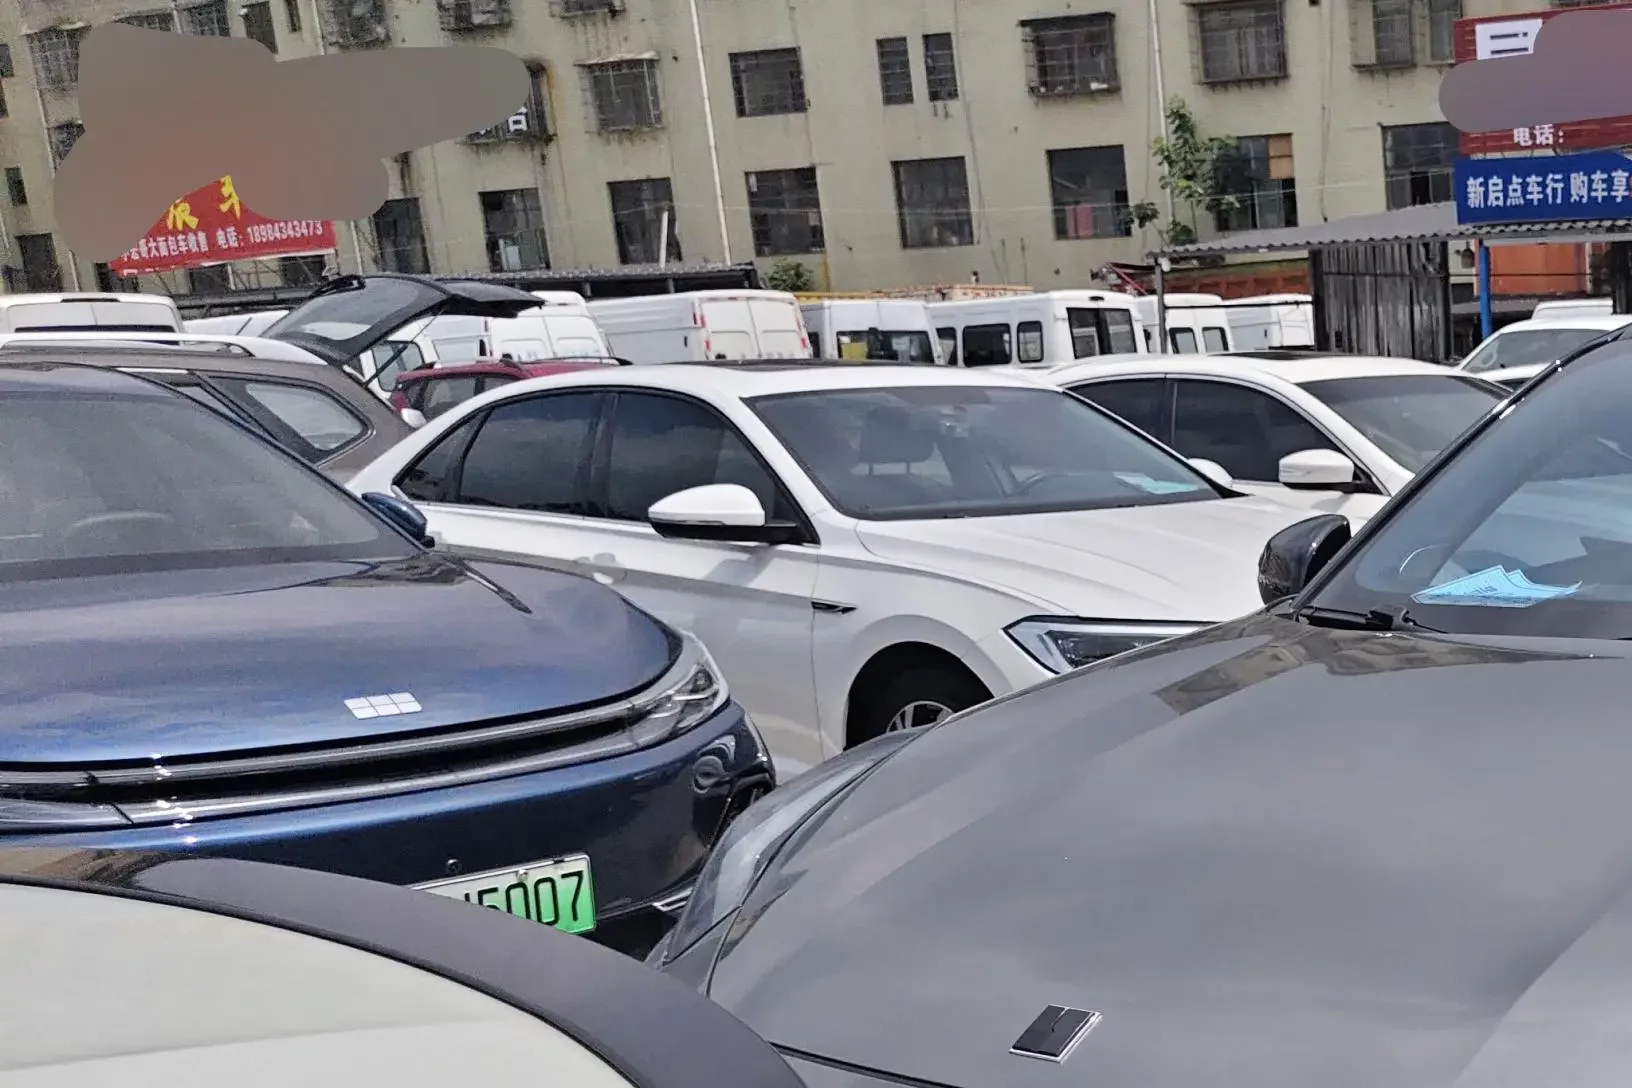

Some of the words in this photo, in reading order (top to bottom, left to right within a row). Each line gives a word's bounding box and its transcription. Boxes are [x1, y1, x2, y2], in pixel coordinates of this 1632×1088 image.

[1466, 173, 1565, 208] 新启点车行
